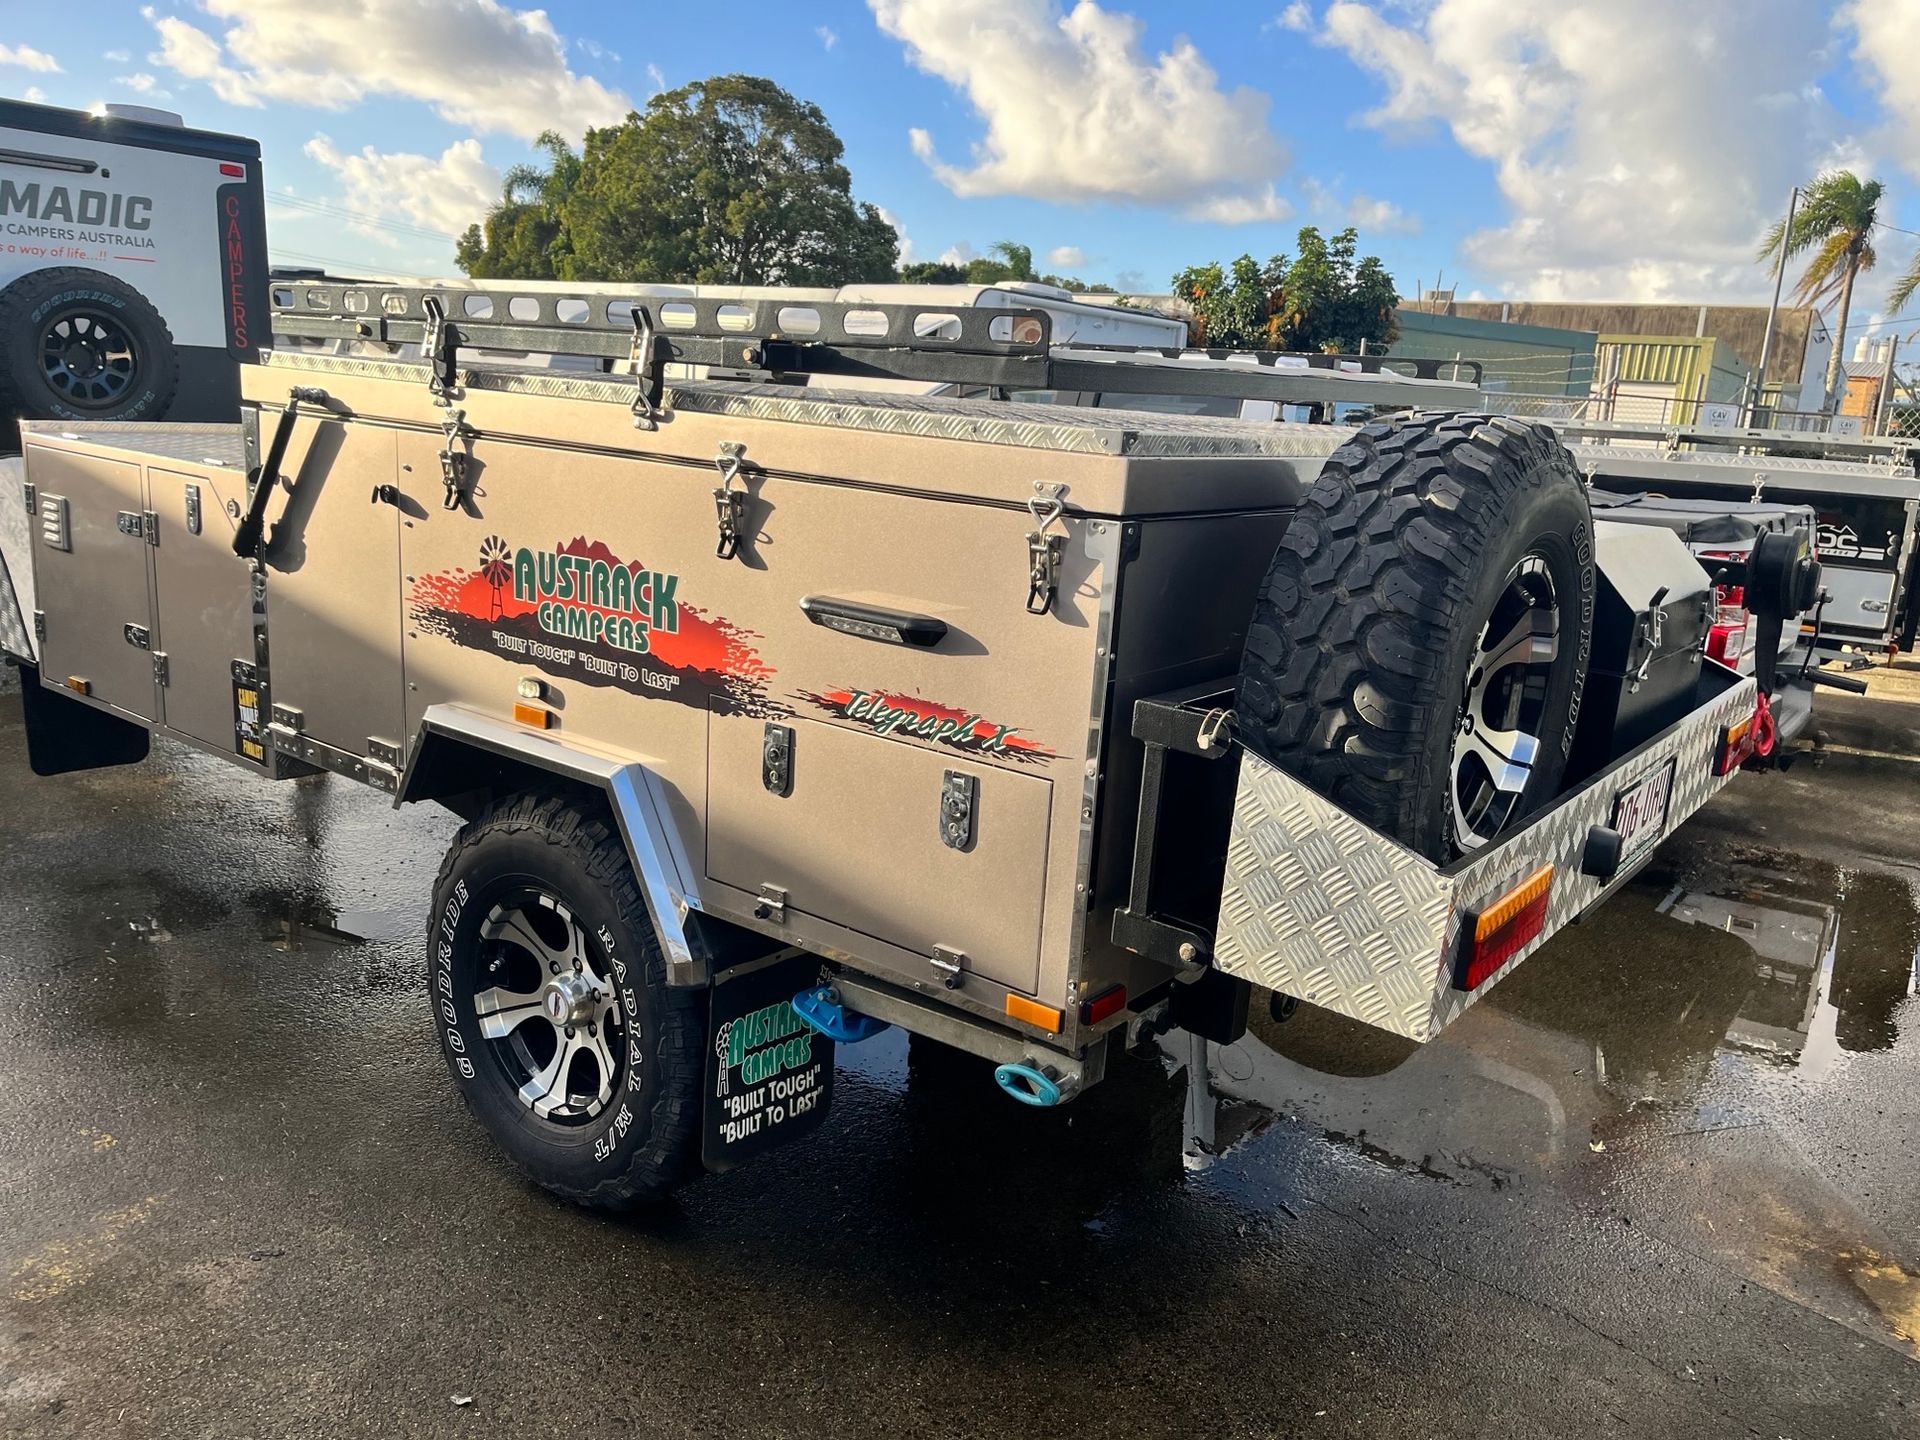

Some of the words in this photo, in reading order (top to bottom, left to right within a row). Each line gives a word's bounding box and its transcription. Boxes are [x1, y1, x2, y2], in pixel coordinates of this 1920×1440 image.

[0, 179, 153, 231] MADIC
[7, 223, 74, 241] CAMPERS
[78, 231, 156, 249] AUSTRALIA
[5, 244, 16, 252] a
[19, 246, 49, 259] way
[50, 247, 64, 257] of
[226, 196, 249, 349] CAMPERS
[513, 547, 680, 634] AUSTRACK
[537, 601, 651, 654] CAMPERS
[1560, 520, 1594, 760] GOODRIDE
[844, 688, 983, 746] Telegraph
[437, 879, 476, 1080] GOODRIDE
[597, 925, 644, 1093] RADIAL
[727, 1000, 822, 1068] AUSTRA
[741, 1033, 812, 1086] CAMPERS
